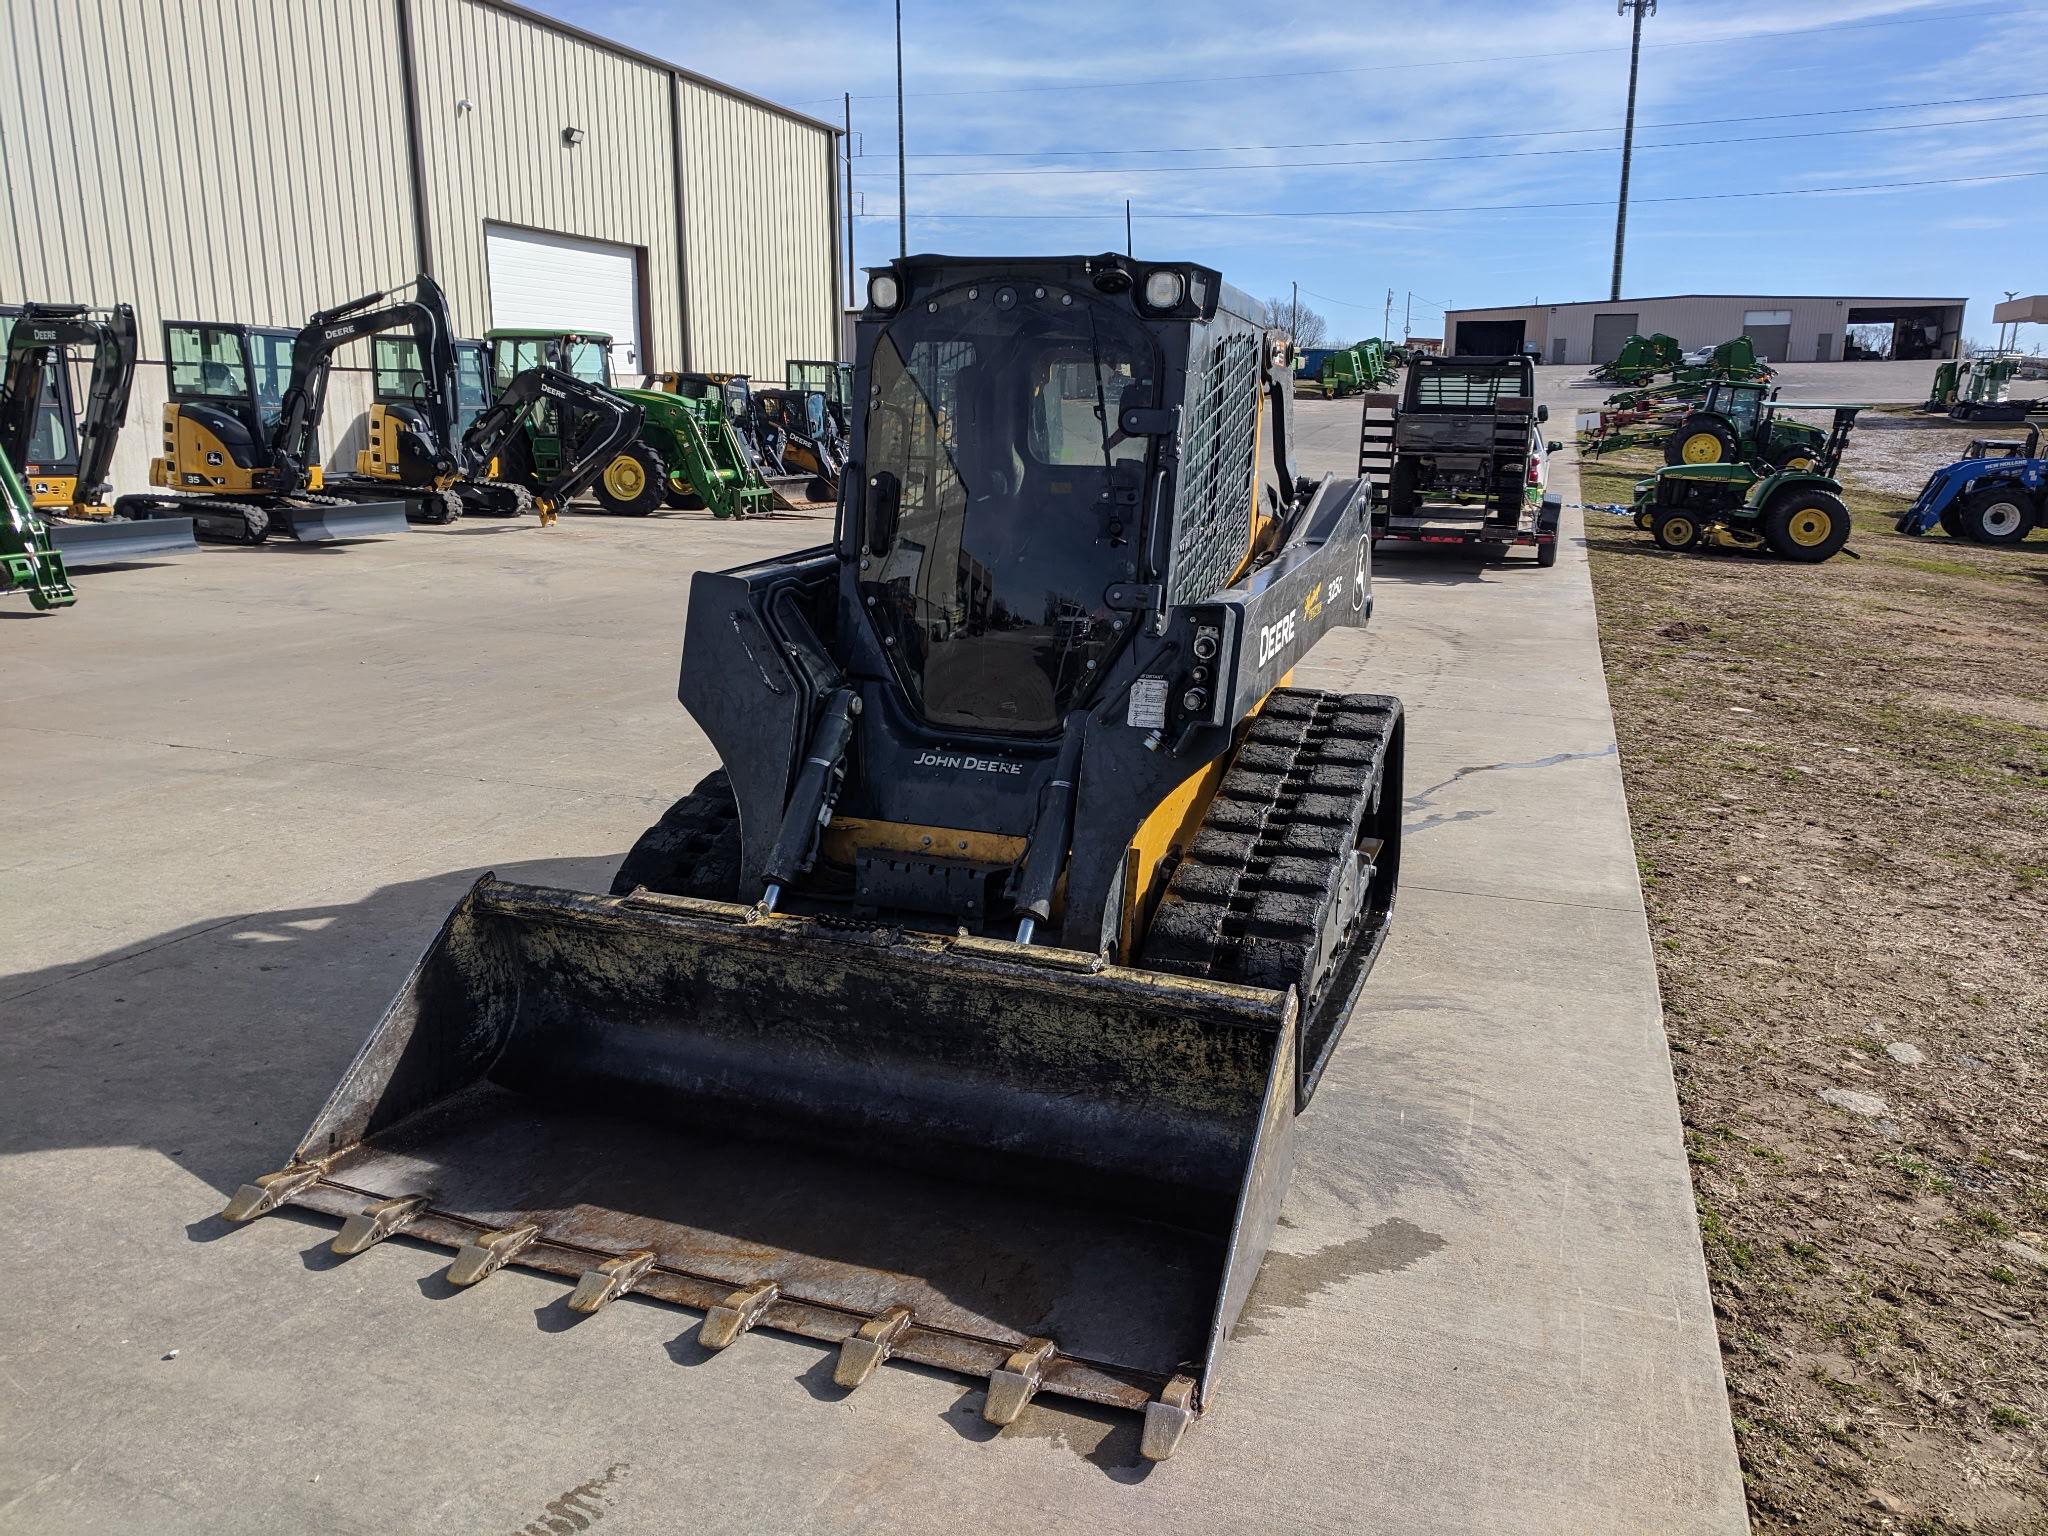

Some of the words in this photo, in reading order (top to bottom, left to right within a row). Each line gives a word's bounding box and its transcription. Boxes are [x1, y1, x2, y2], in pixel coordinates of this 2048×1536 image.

[34, 329, 57, 340] DEERE
[325, 325, 355, 340] DEERE
[541, 383, 566, 399] DEERE
[789, 432, 813, 449] DEERE
[1999, 459, 2028, 468] HOLLAND
[187, 475, 200, 484] 35
[1259, 608, 1297, 668] DEERE
[913, 752, 961, 768] JOHN
[963, 756, 1023, 775] DEERE
